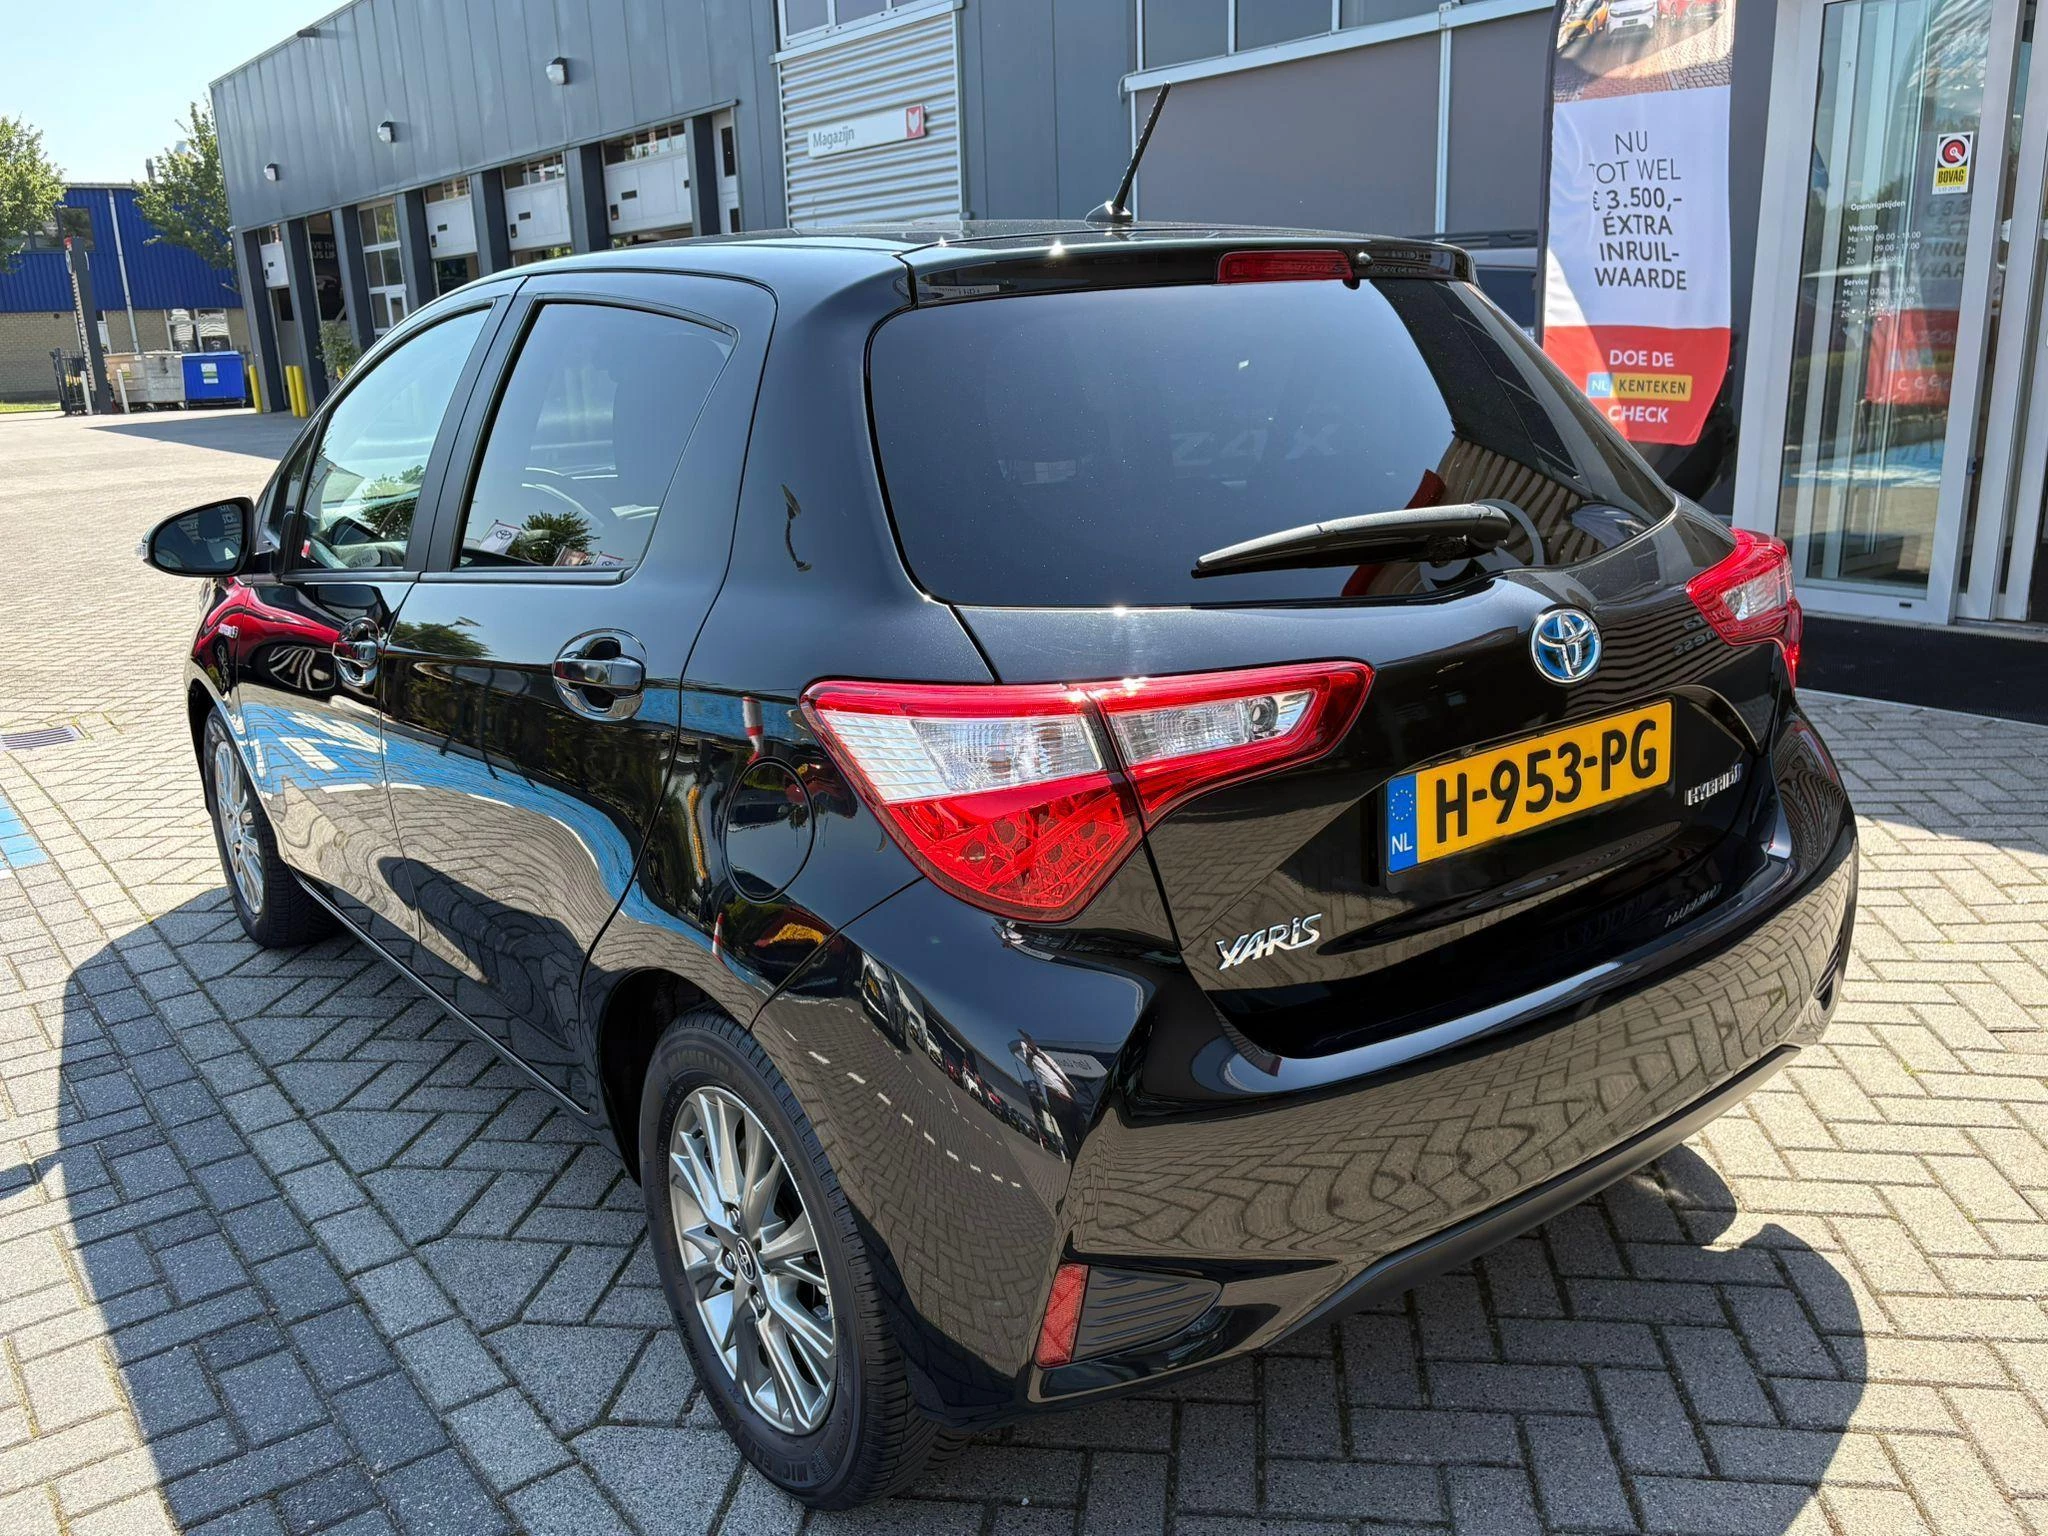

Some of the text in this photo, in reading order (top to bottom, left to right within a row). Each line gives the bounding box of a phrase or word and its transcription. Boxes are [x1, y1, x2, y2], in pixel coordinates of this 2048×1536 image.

[812, 126, 855, 149] Magazijn
[1615, 130, 1647, 155] NU
[1636, 158, 1682, 181] WEL
[1937, 168, 1965, 184] BOVAG
[1606, 187, 1683, 212] 3.500,-
[1850, 200, 1906, 211] Openingstijden
[1847, 235, 1858, 243] Ma
[1875, 232, 1896, 241] 09.00
[1848, 224, 1879, 232] Verkoop
[1600, 241, 1680, 262] INRUIL-
[1594, 267, 1687, 291] WAARDE
[1843, 278, 1869, 286] Service
[1610, 350, 1675, 368] DOE DE
[1591, 378, 1686, 395] NL KENTEKEN
[1607, 405, 1670, 424] CHECK
[1434, 719, 1658, 845] H-953-PG
[1685, 768, 1736, 807] HYBRID
[1391, 834, 1413, 856] NL
